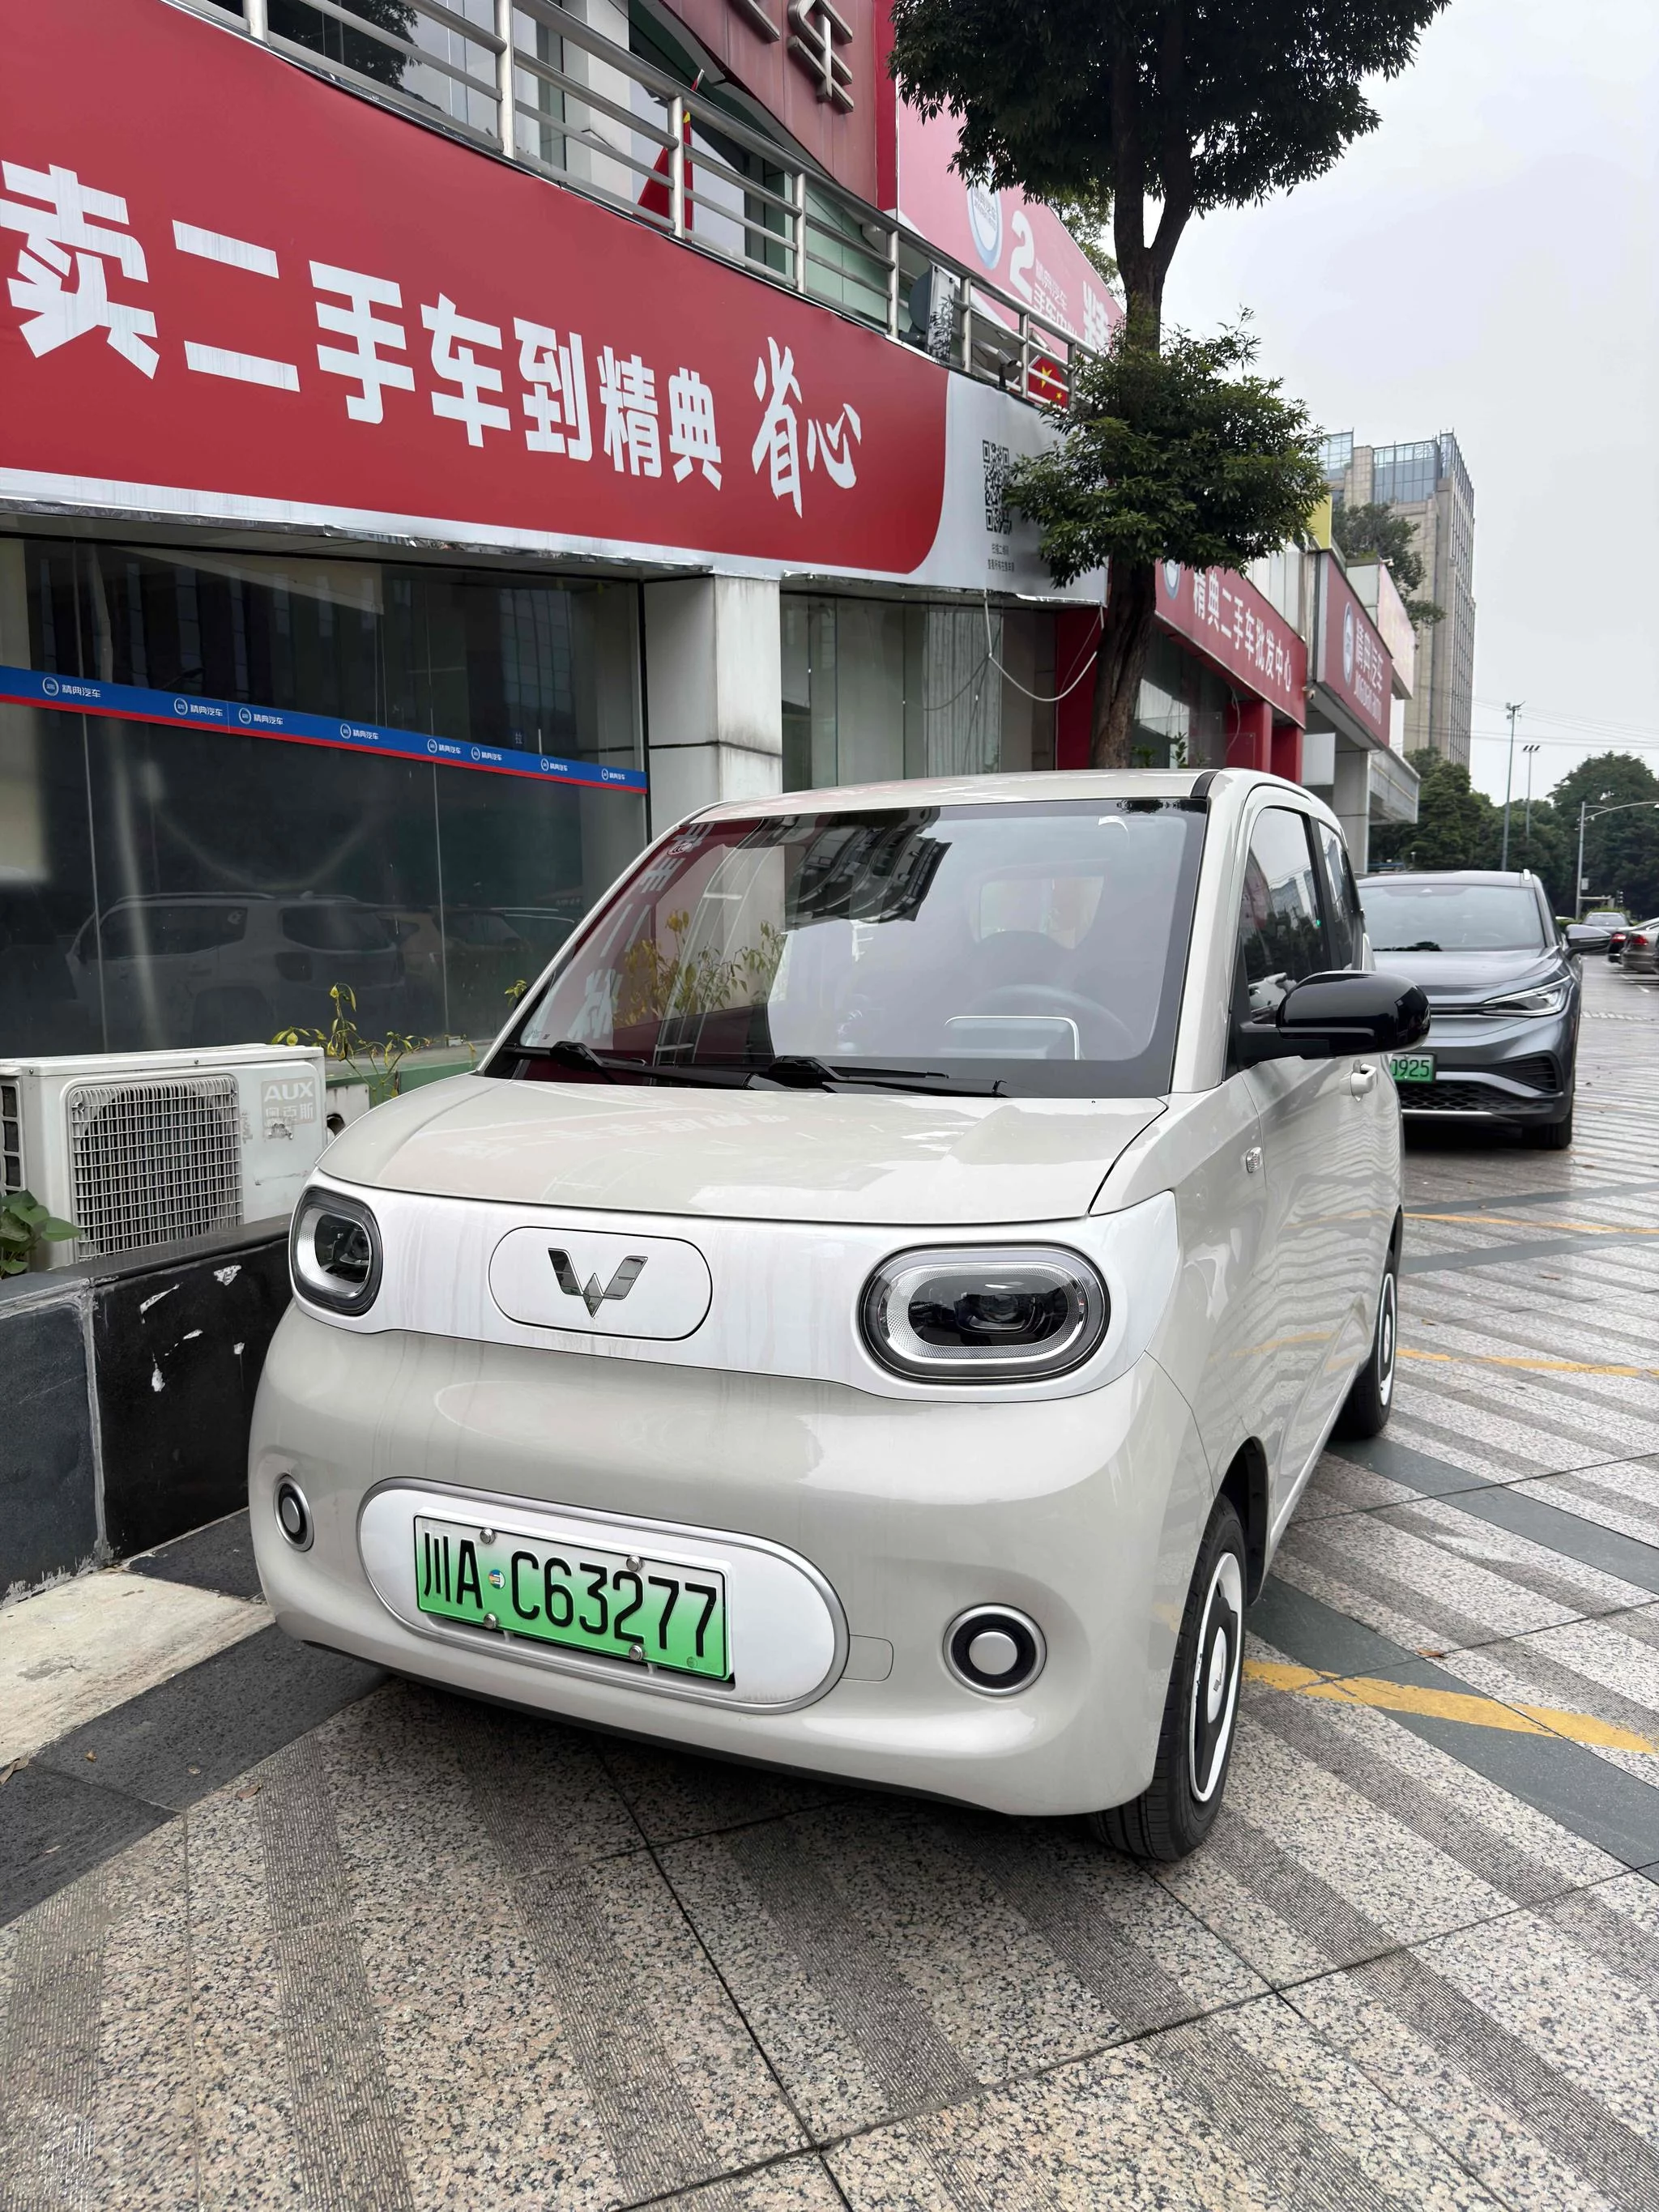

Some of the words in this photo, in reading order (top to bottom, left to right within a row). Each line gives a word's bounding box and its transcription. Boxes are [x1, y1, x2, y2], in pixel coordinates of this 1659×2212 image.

[0, 160, 723, 492] 卖二手车到精典
[751, 336, 862, 518] 省心
[1192, 569, 1292, 693] 精典二手车批发中心
[62, 684, 101, 698] 精典汽车
[190, 703, 224, 718] 精典汽车
[253, 713, 284, 726] 精典汽车
[352, 728, 379, 740] 精典汽车
[438, 743, 462, 754] 精典汽车
[480, 750, 503, 761] 精典汽车
[264, 1080, 314, 1102] AUX
